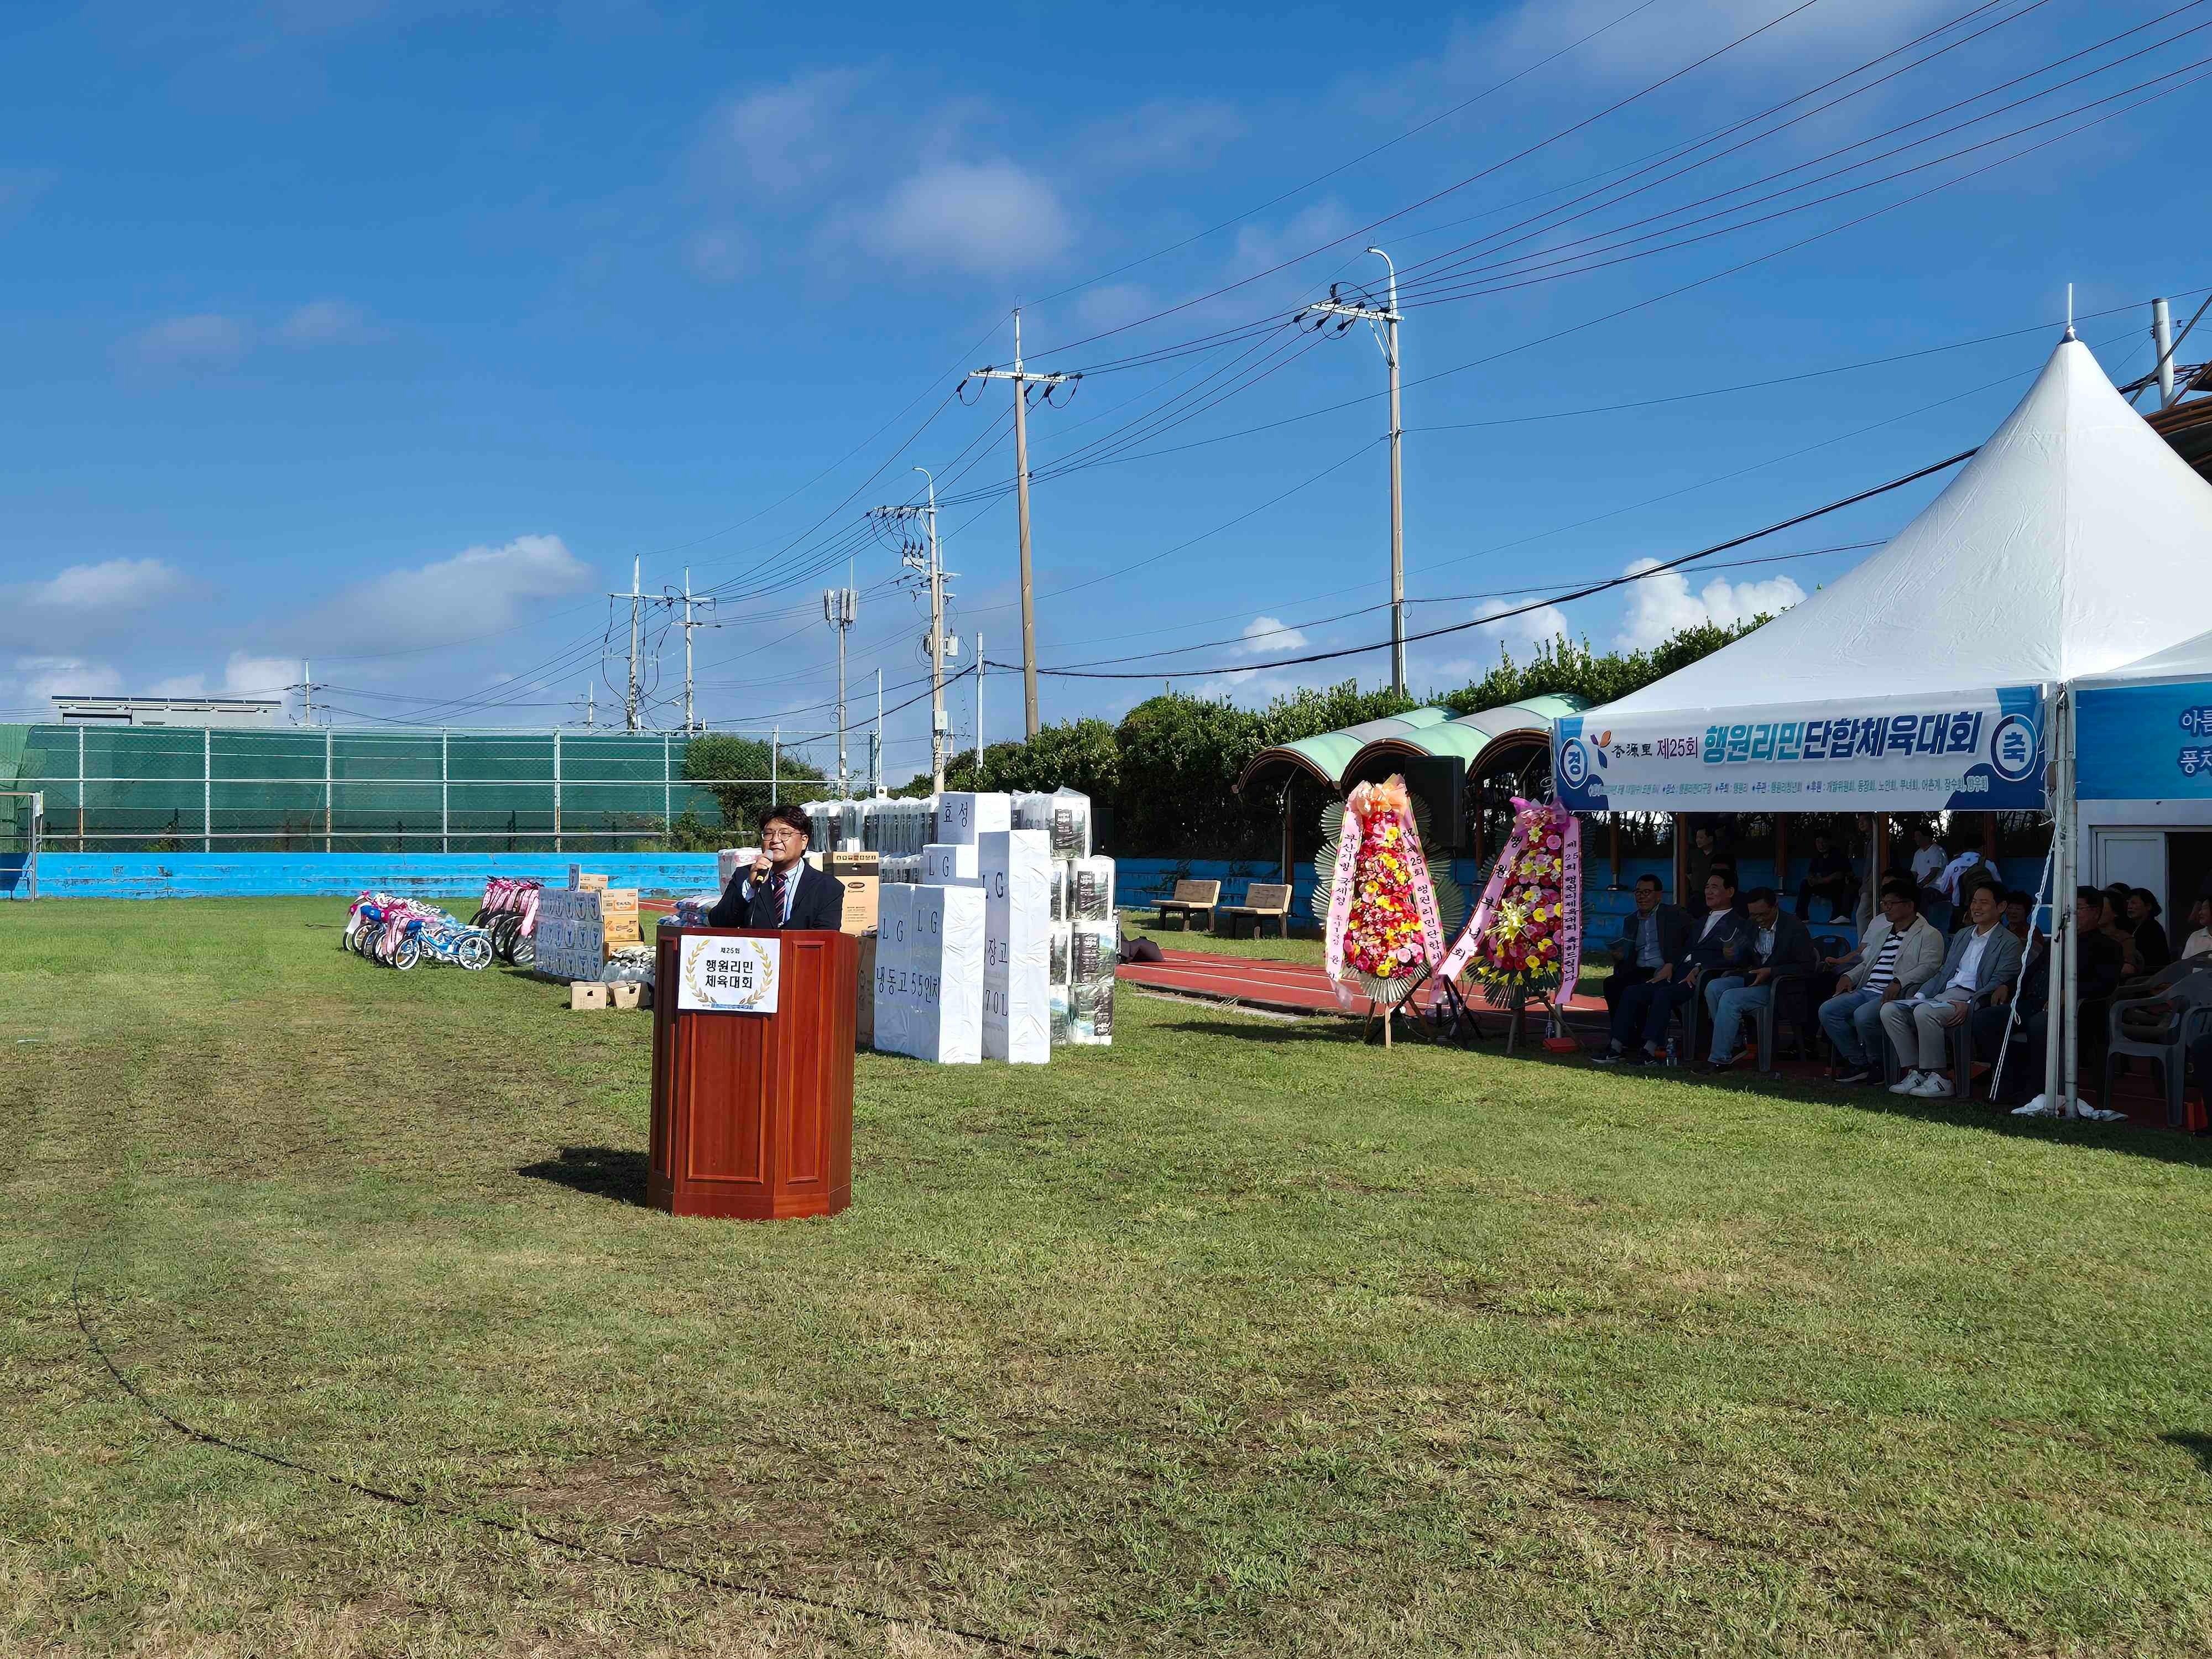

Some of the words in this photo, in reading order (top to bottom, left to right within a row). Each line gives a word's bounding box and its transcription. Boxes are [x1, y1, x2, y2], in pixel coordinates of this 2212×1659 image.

[1657, 737, 1698, 759] 제25회
[1703, 711, 1983, 763] 행원리민단합체육대회
[2002, 732, 2026, 763] 축
[943, 802, 968, 827] 효성
[706, 959, 753, 974] 행원리민
[877, 966, 907, 995] 냉동고
[705, 975, 753, 989] 체육대회
[911, 972, 940, 1005] 55인치
